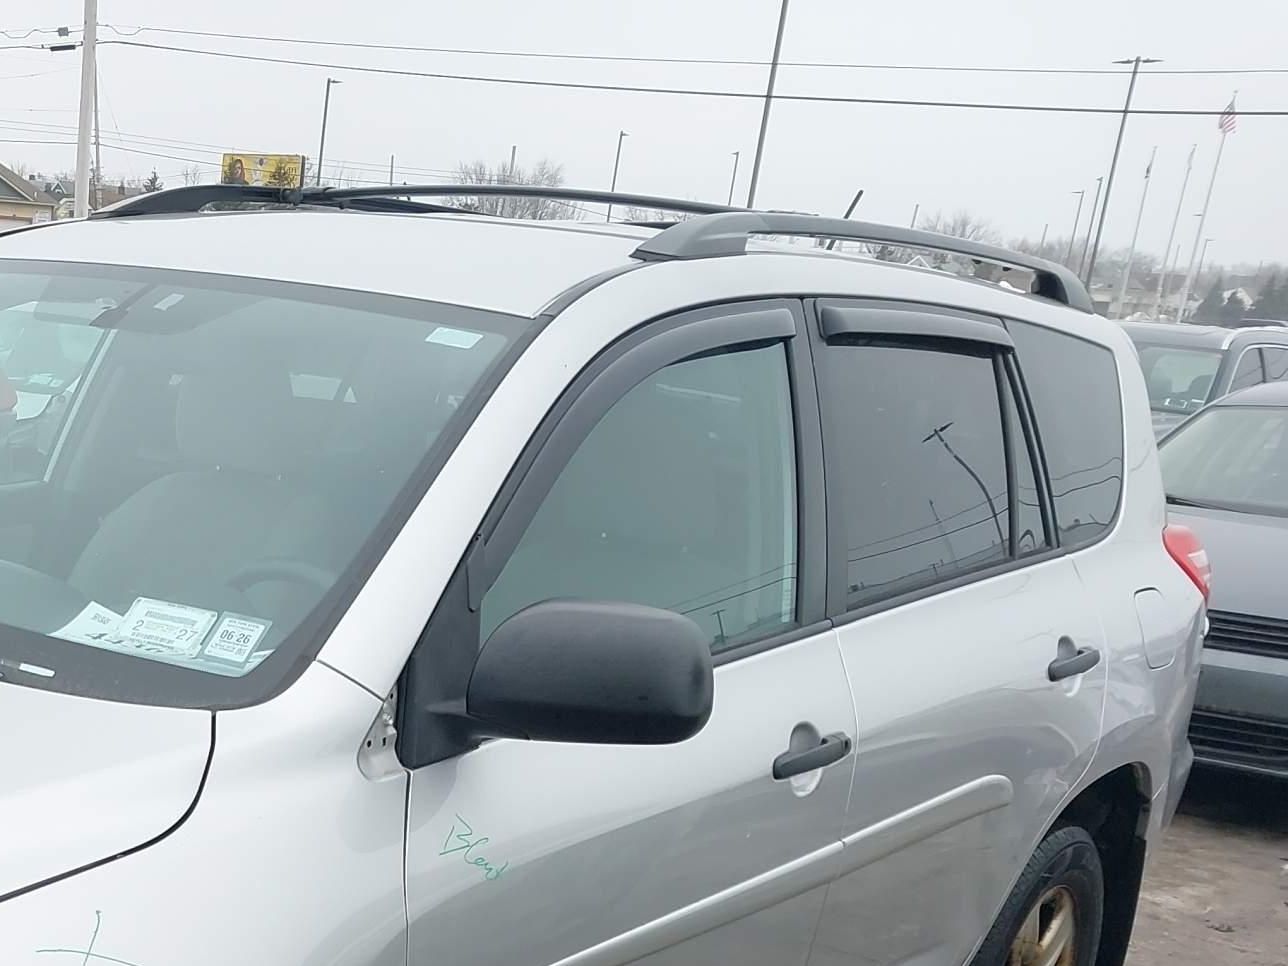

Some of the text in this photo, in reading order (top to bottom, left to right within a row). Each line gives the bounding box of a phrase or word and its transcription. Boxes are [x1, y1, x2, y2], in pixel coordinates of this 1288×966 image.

[131, 619, 145, 631] 2
[176, 628, 199, 642] 27
[220, 629, 252, 644] 06 26
